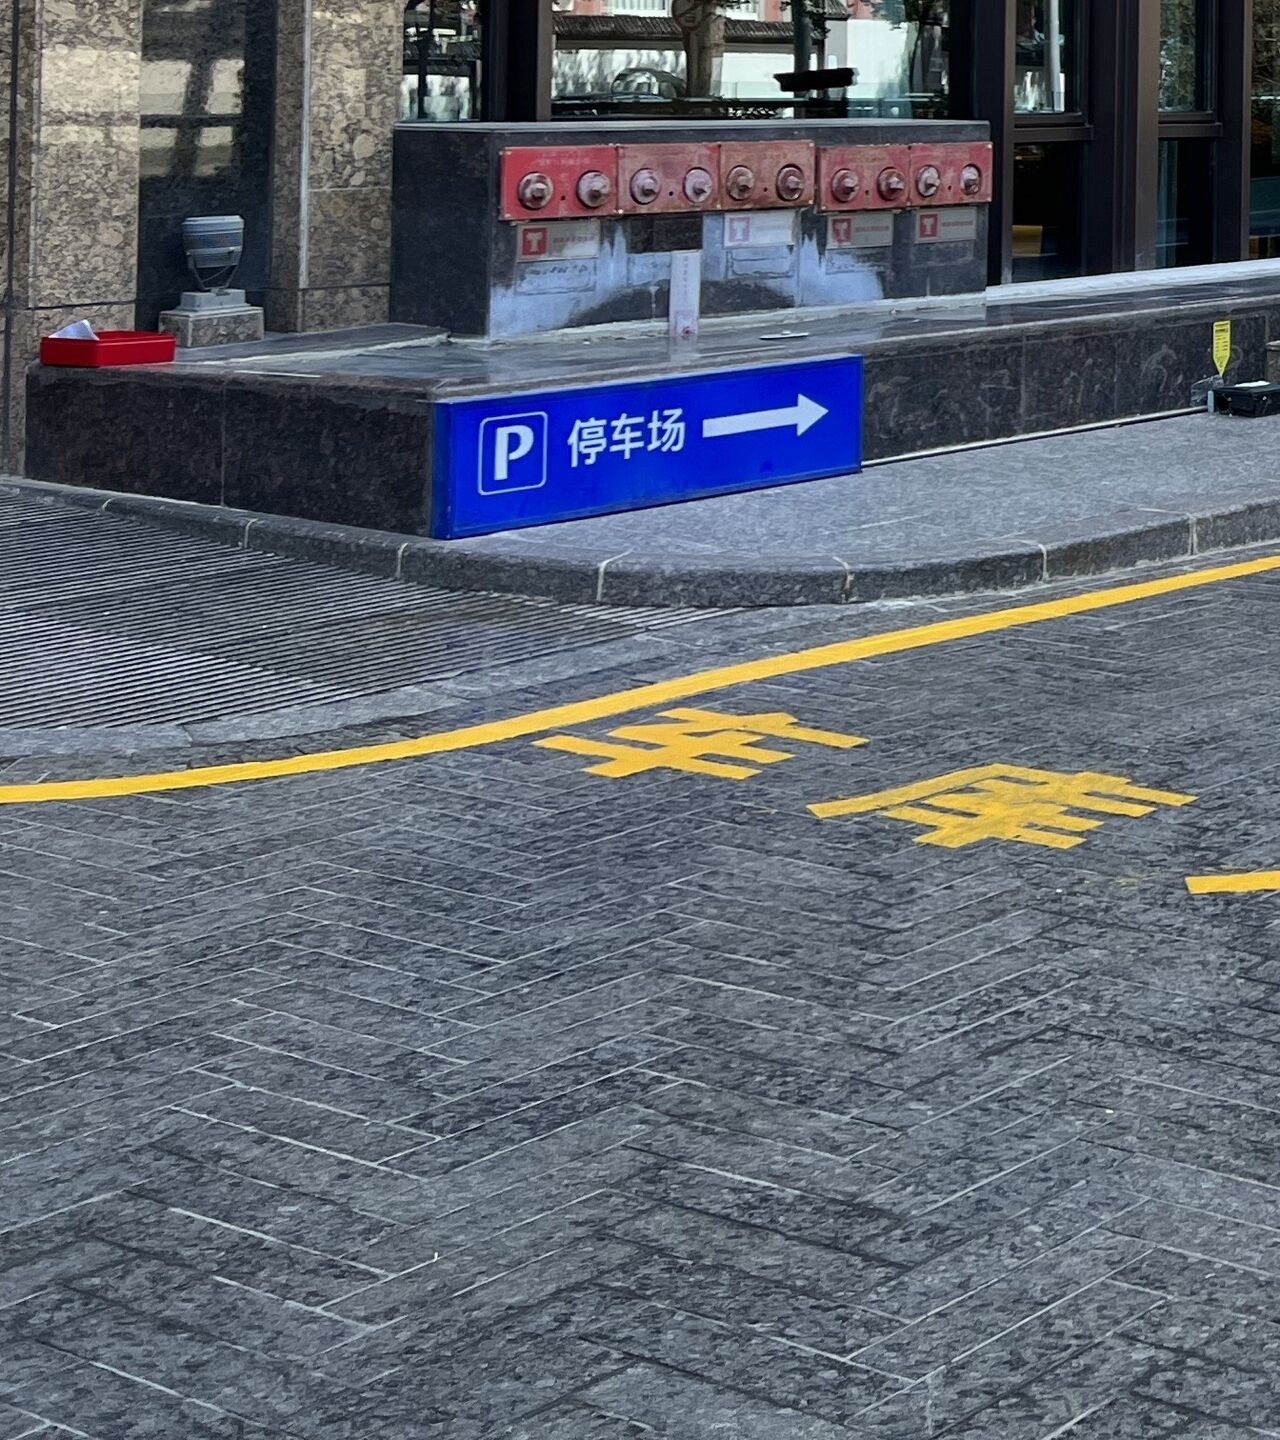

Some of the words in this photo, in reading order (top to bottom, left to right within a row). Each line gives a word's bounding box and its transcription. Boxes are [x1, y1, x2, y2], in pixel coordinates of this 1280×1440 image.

[494, 425, 534, 481] P
[567, 408, 686, 468] 停车场
